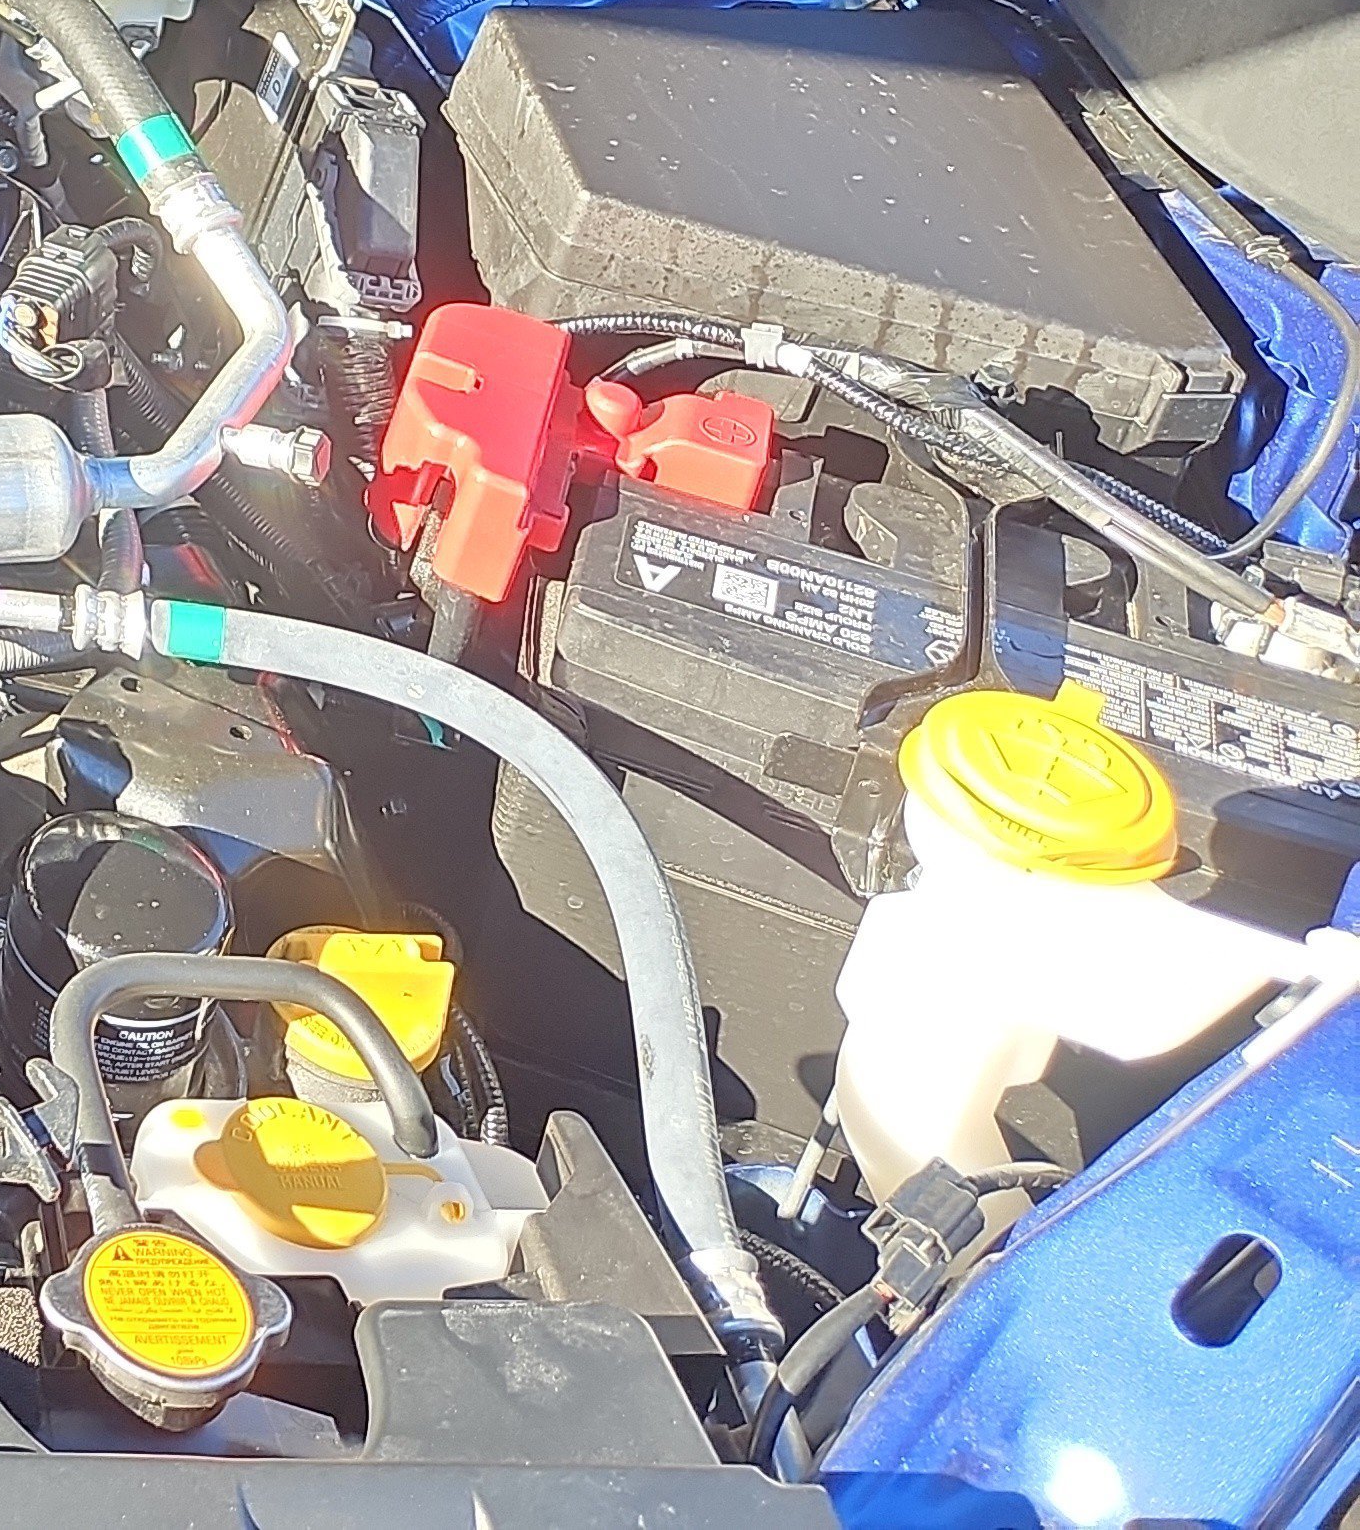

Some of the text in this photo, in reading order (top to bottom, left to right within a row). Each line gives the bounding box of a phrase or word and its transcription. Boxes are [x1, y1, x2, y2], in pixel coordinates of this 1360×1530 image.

[838, 603, 874, 623] LN2
[785, 610, 837, 634] AMPS
[829, 612, 872, 632] GROUP
[724, 603, 870, 654] COLD CRANKING AMPS
[118, 1029, 175, 1041] CAUTION
[133, 1248, 193, 1257] WARNING
[101, 1288, 226, 1296] NEVER OPEN WHEN HOT
[120, 1297, 150, 1306] JAMAIS
[134, 1334, 227, 1345] AVERTISSEMENT
